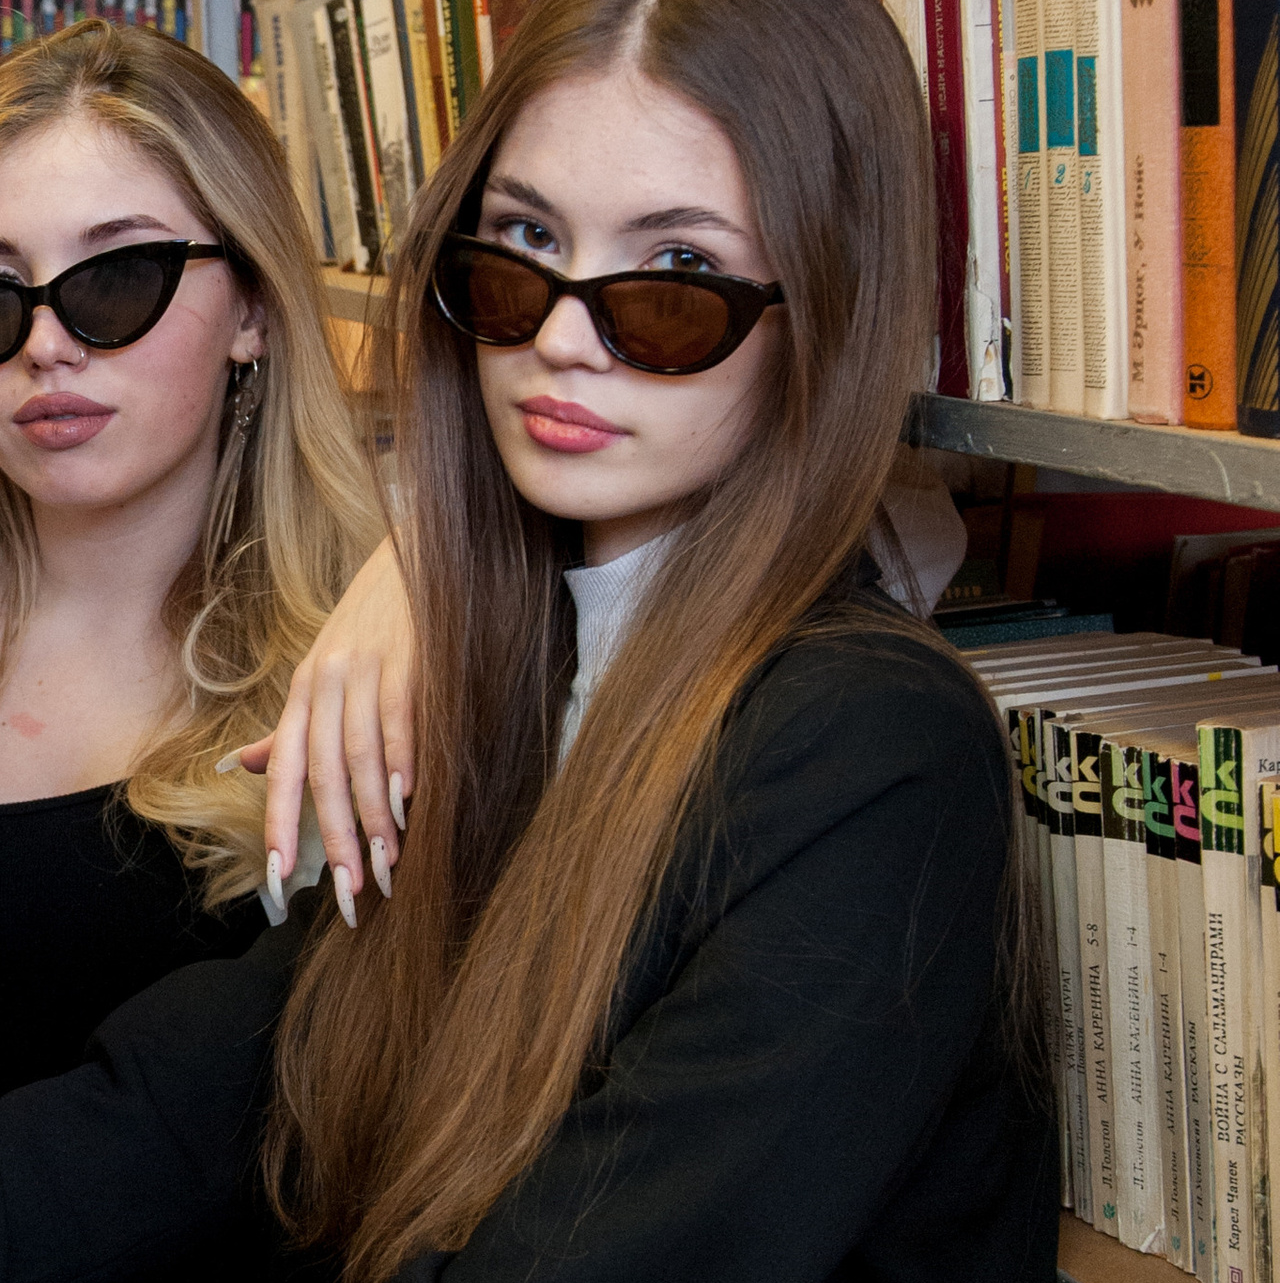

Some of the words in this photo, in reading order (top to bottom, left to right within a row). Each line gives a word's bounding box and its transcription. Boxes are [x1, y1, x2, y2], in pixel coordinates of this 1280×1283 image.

[1054, 163, 1066, 185] 2
[1086, 922, 1100, 947] 5-8
[1126, 925, 1139, 948] 1-4
[1157, 951, 1168, 974] 1-4
[1208, 911, 1229, 1056] САЛАМАНДРАМИ
[1089, 963, 1106, 1052] КАРЕНИНА
[1127, 964, 1142, 1053] КАРЕНИНА
[1159, 992, 1174, 1082] КАРЕНИНА
[1094, 1058, 1108, 1104] АННА
[1129, 1059, 1143, 1105] АННА
[1187, 1020, 1200, 1106] РАССКАЗЫ
[1164, 1089, 1176, 1136] АННА
[1213, 1081, 1232, 1143] ВОЙНА
[1233, 1054, 1247, 1147] РАССКАЗЫ
[1099, 1119, 1114, 1190] Л.Толстой
[1225, 1159, 1240, 1204] Чапек
[1227, 1207, 1242, 1252] Карел
